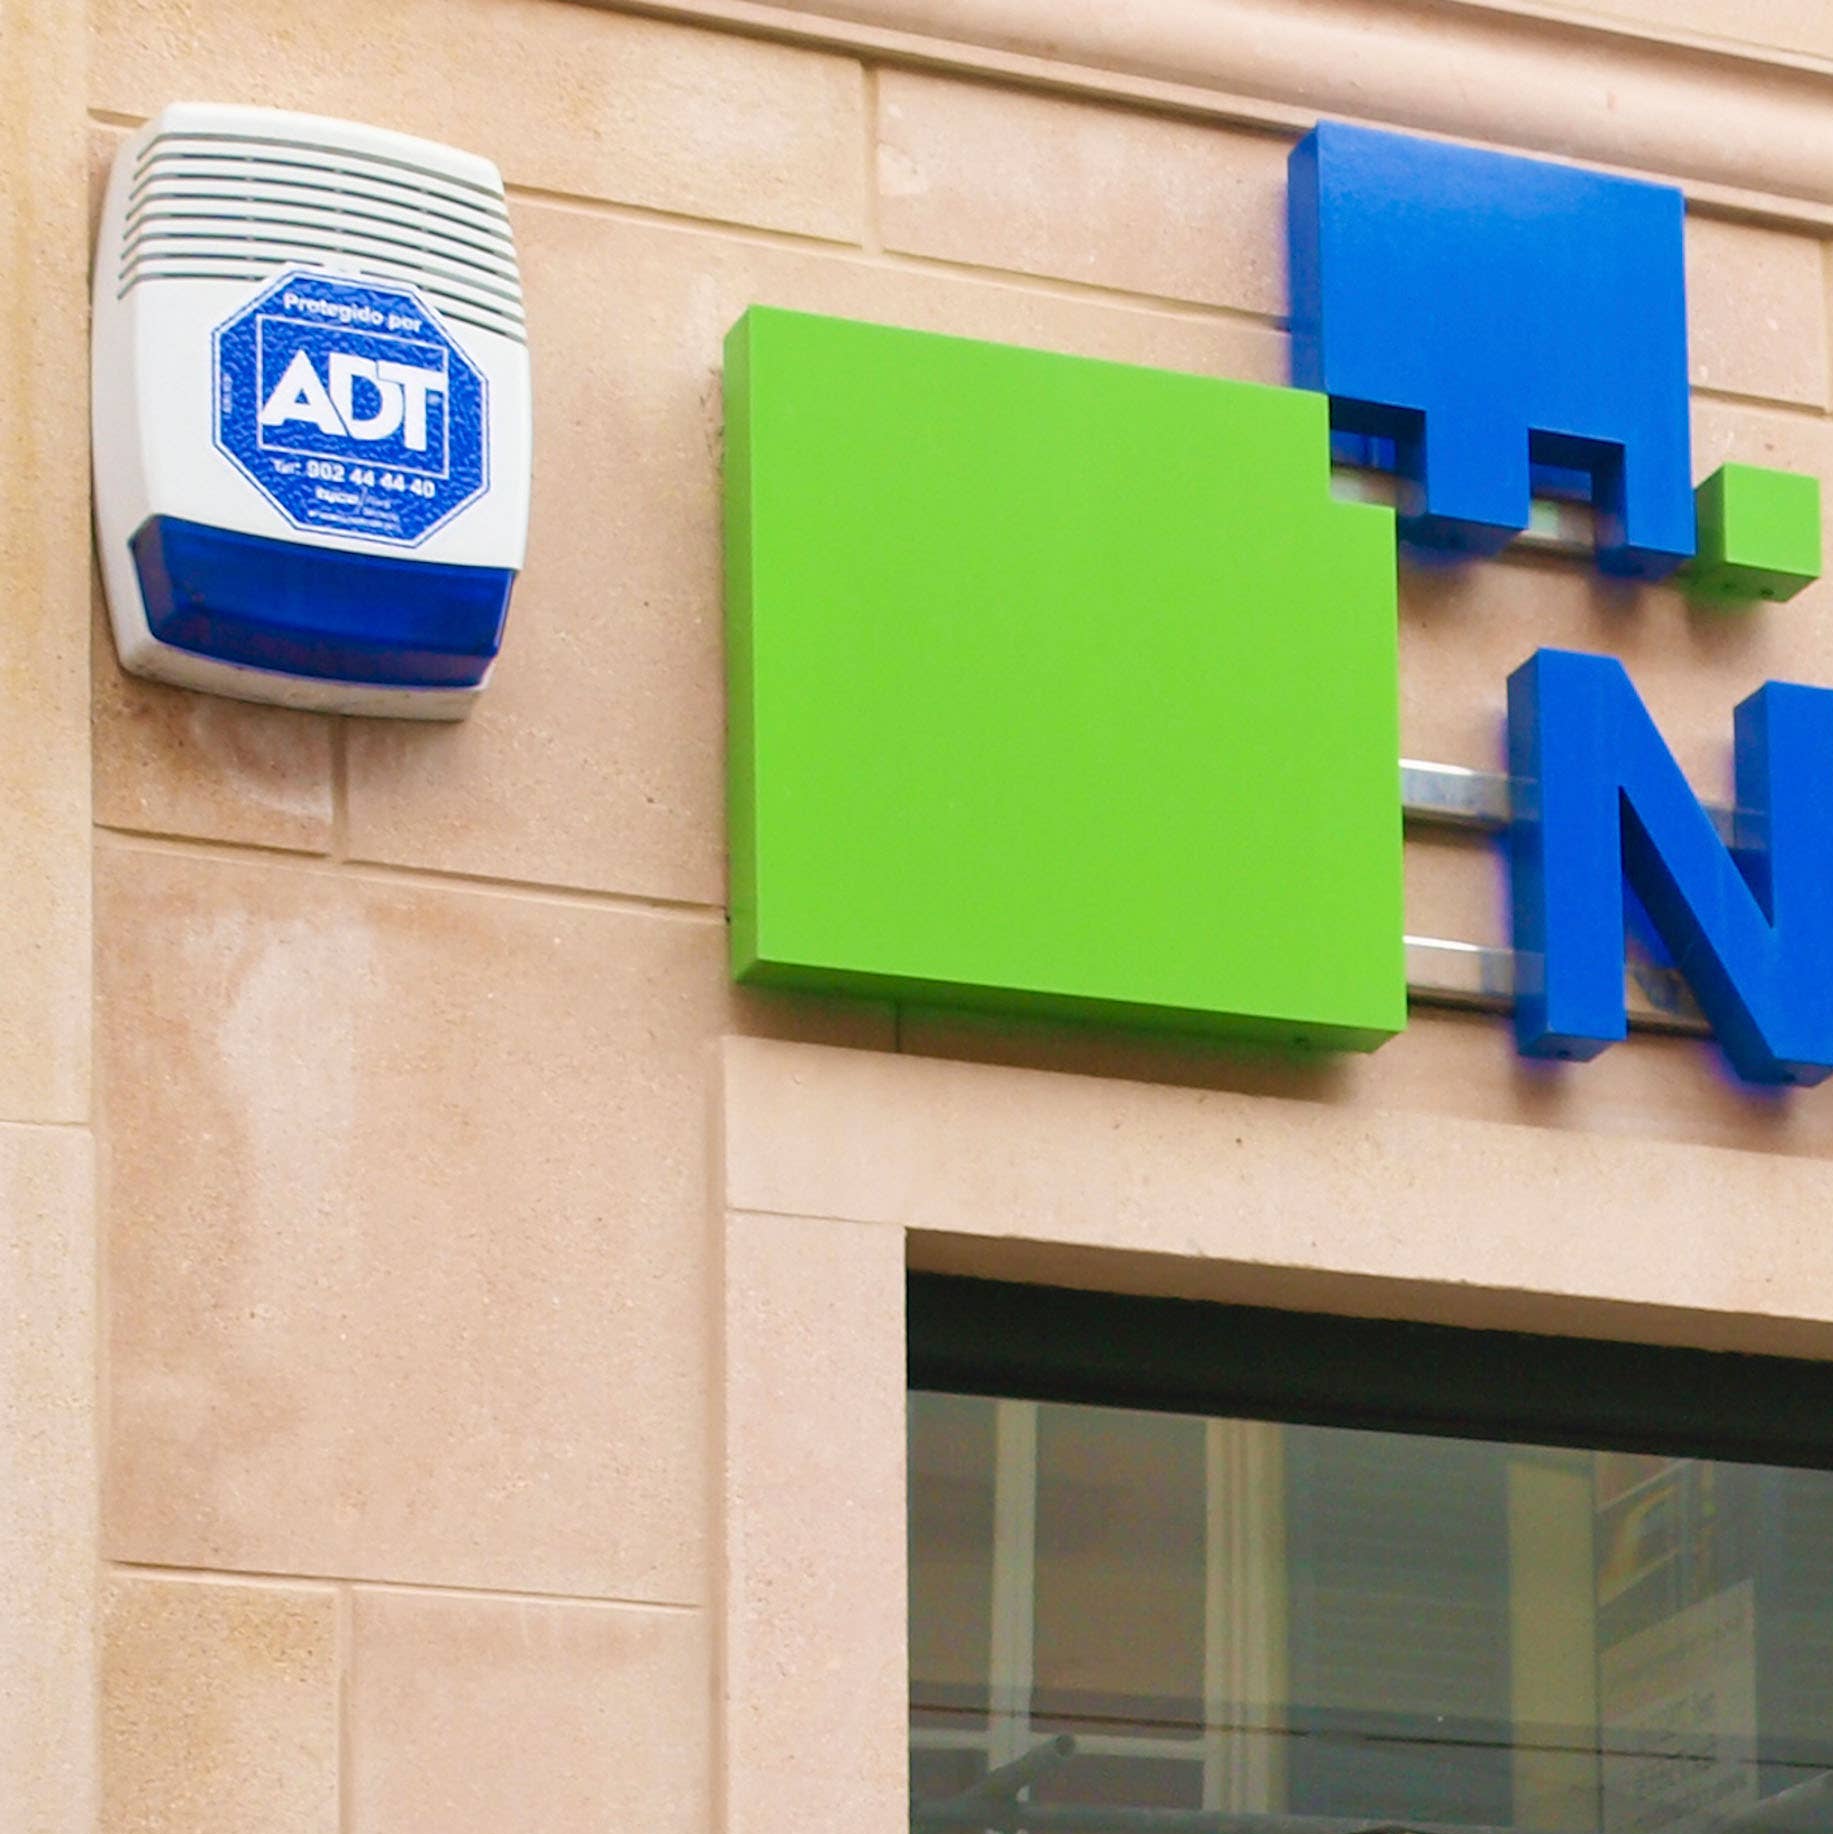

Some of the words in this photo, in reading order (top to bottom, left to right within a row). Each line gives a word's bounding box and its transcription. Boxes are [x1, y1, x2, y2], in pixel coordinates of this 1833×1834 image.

[283, 292, 383, 326] Protegido
[387, 314, 423, 333] por
[260, 349, 446, 452] ADT
[306, 460, 345, 484] 902
[350, 468, 375, 488] 44
[379, 472, 405, 492] 44
